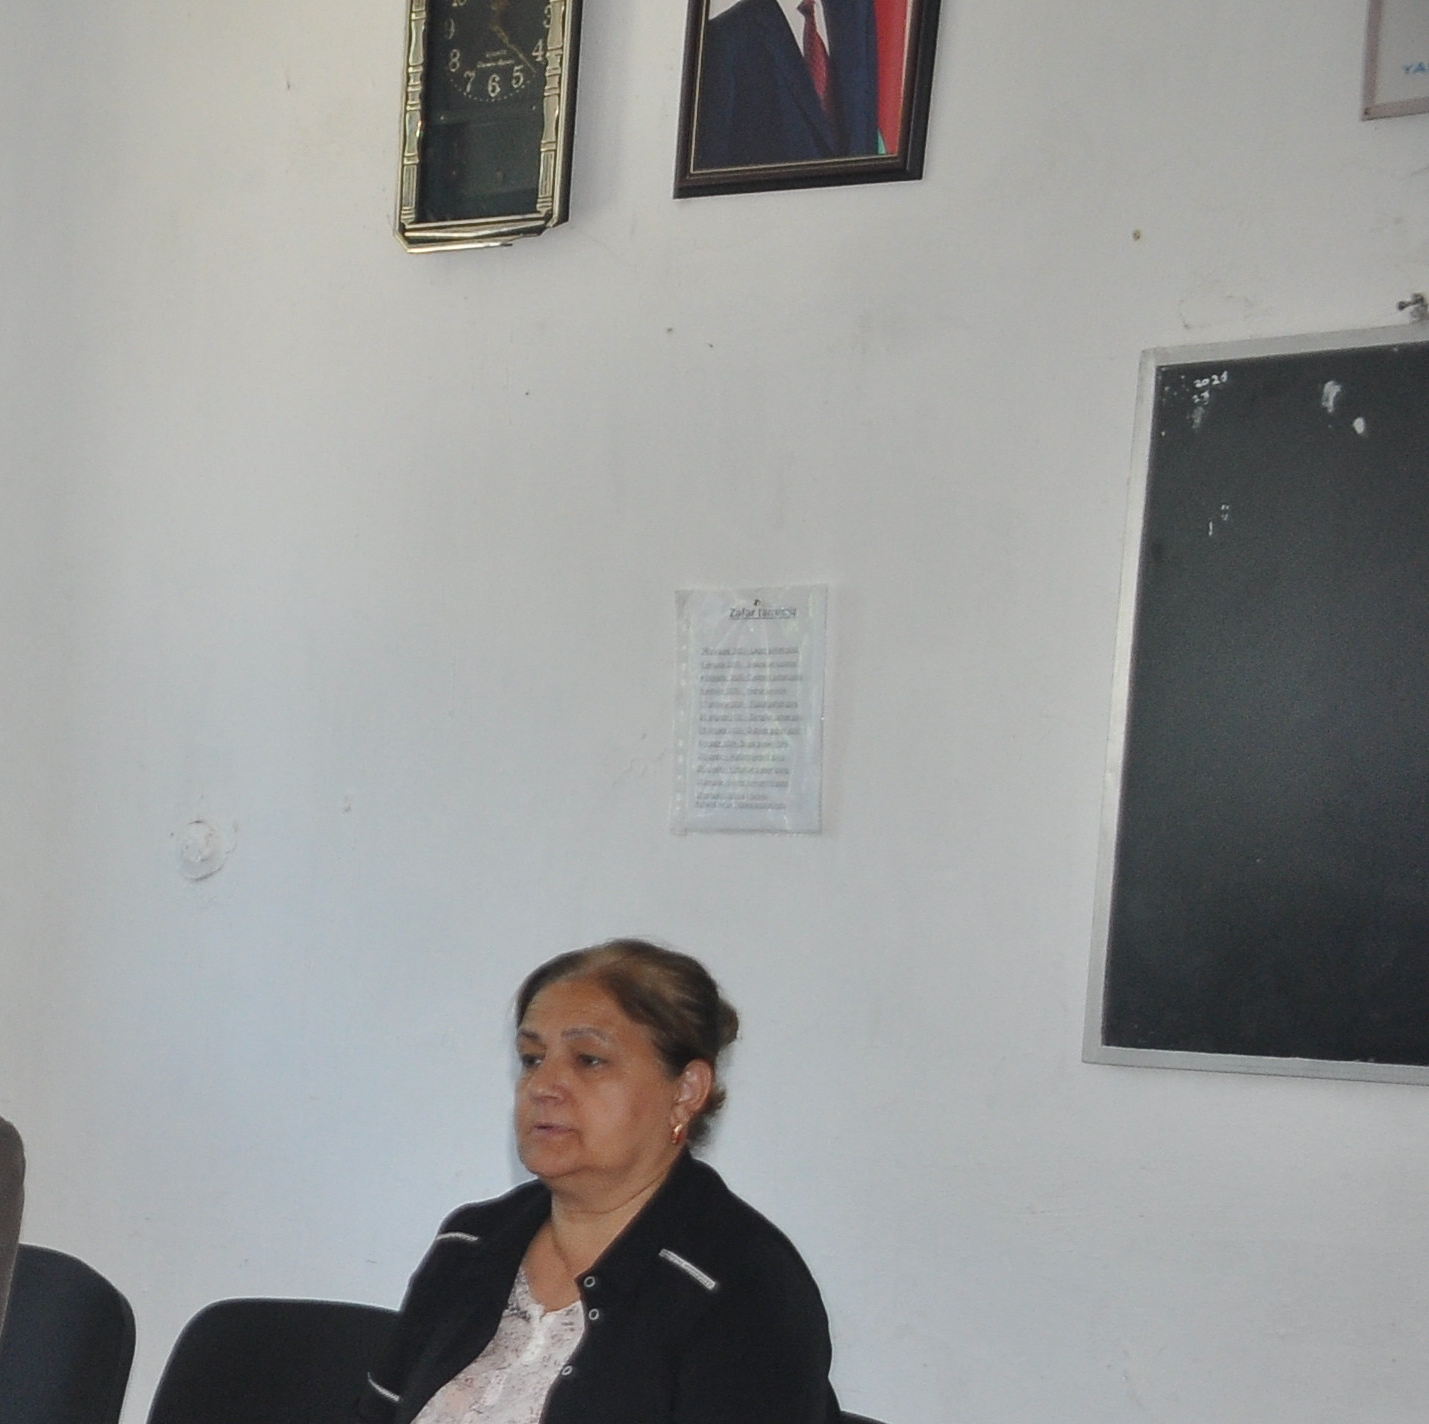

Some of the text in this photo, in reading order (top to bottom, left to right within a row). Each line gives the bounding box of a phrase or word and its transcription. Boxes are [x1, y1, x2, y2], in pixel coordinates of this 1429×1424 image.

[449, 49, 460, 72] 8
[532, 39, 544, 61] 4
[464, 65, 524, 97] 7 6 5
